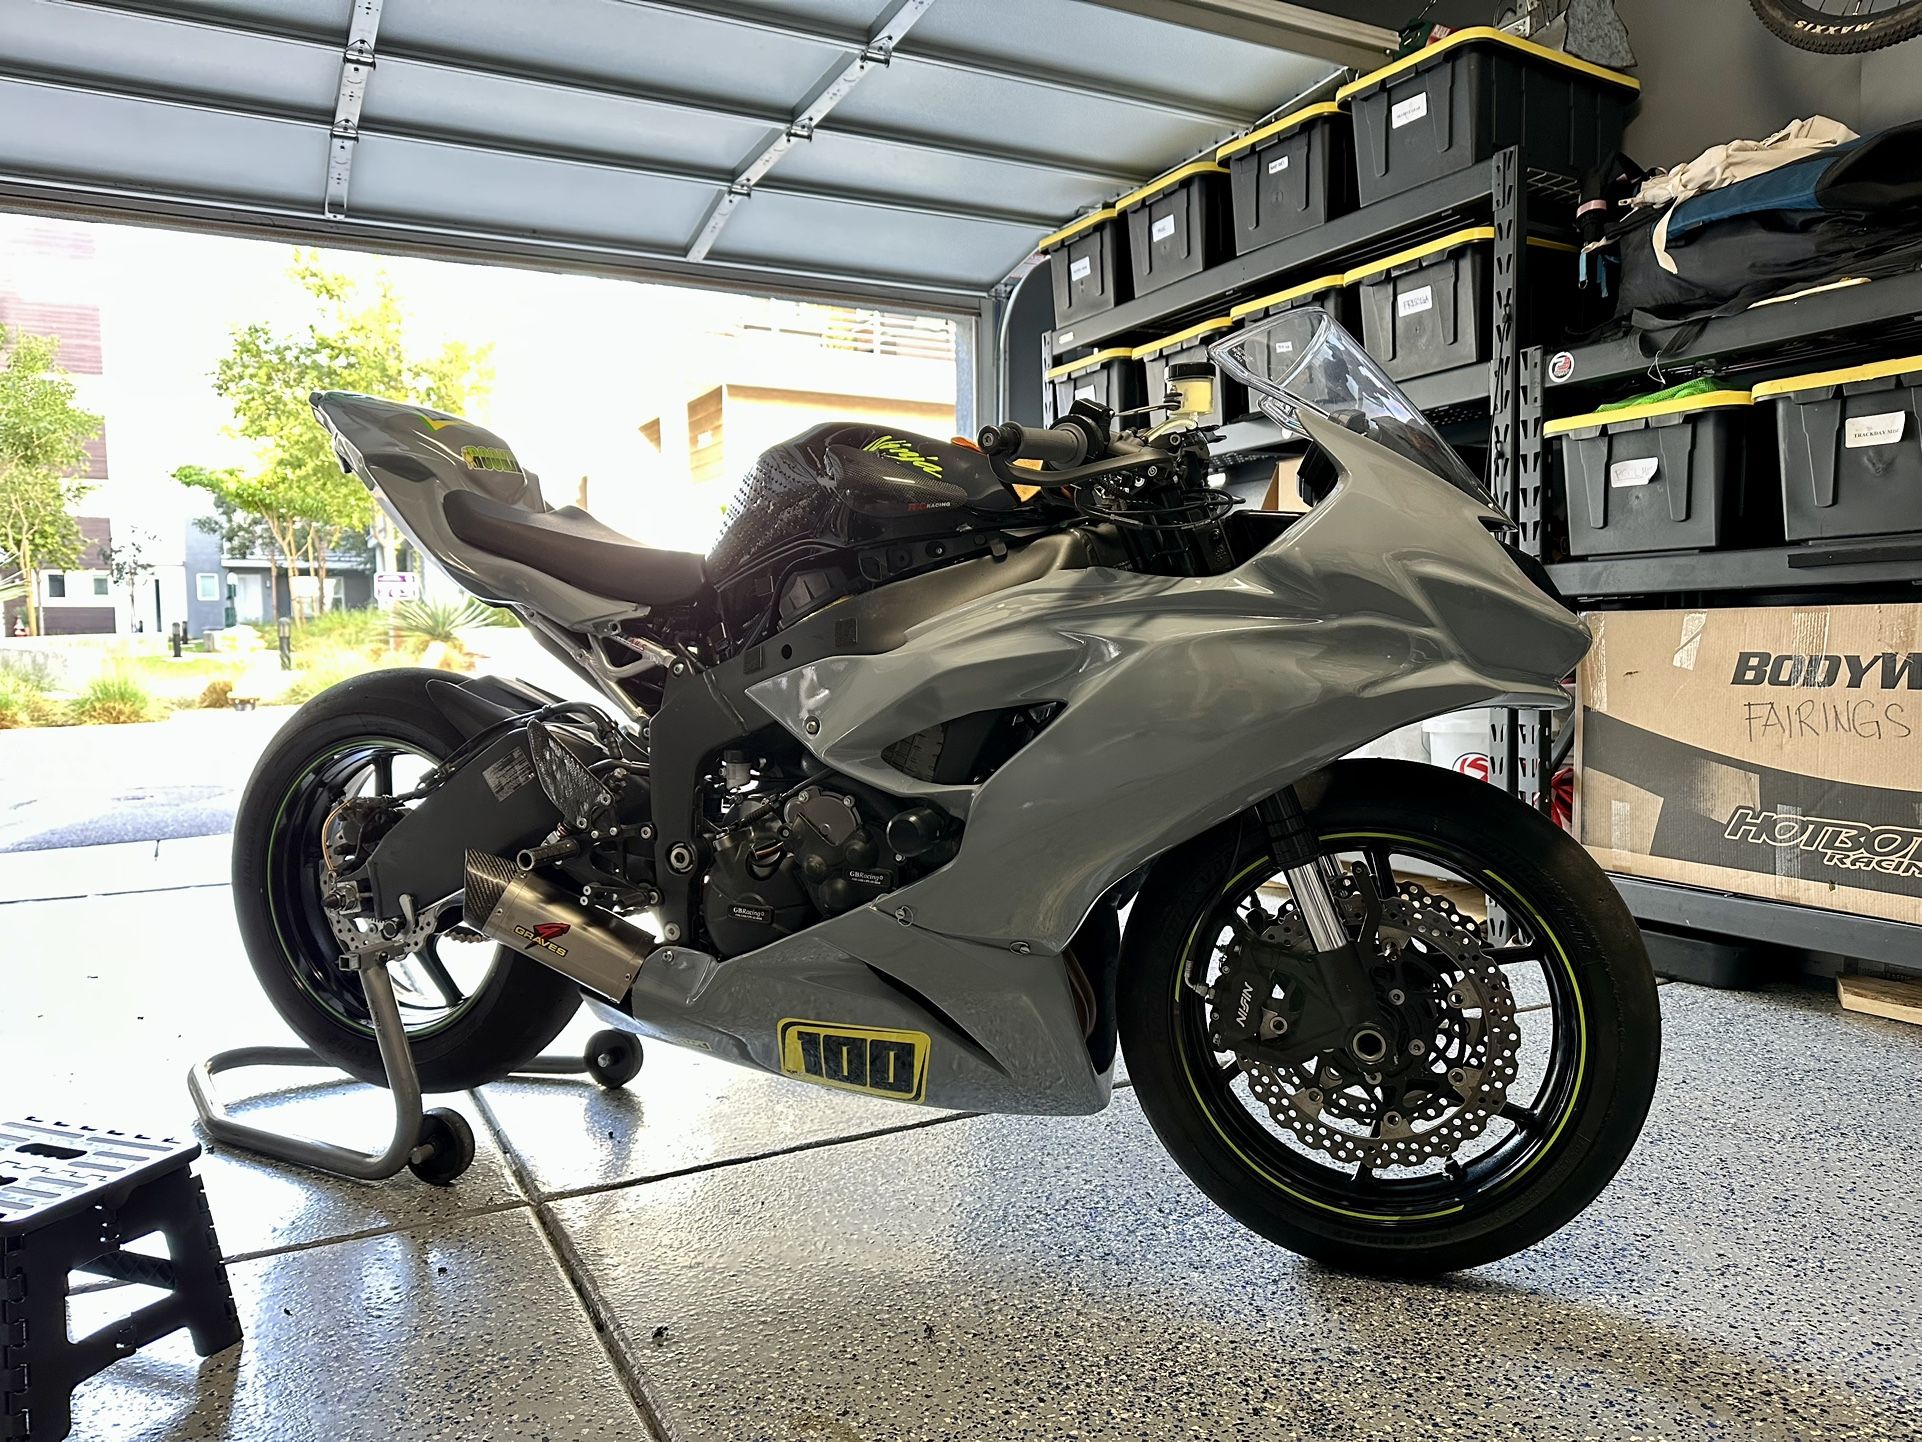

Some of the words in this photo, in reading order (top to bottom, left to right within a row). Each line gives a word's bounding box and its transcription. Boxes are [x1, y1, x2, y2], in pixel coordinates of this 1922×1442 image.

[1794, 20, 1875, 35] MAXXIS
[862, 435, 943, 478] Ninja
[1743, 699, 1912, 743] FAIRINGS
[513, 925, 568, 957] GRAVES
[797, 1031, 915, 1094] 100
